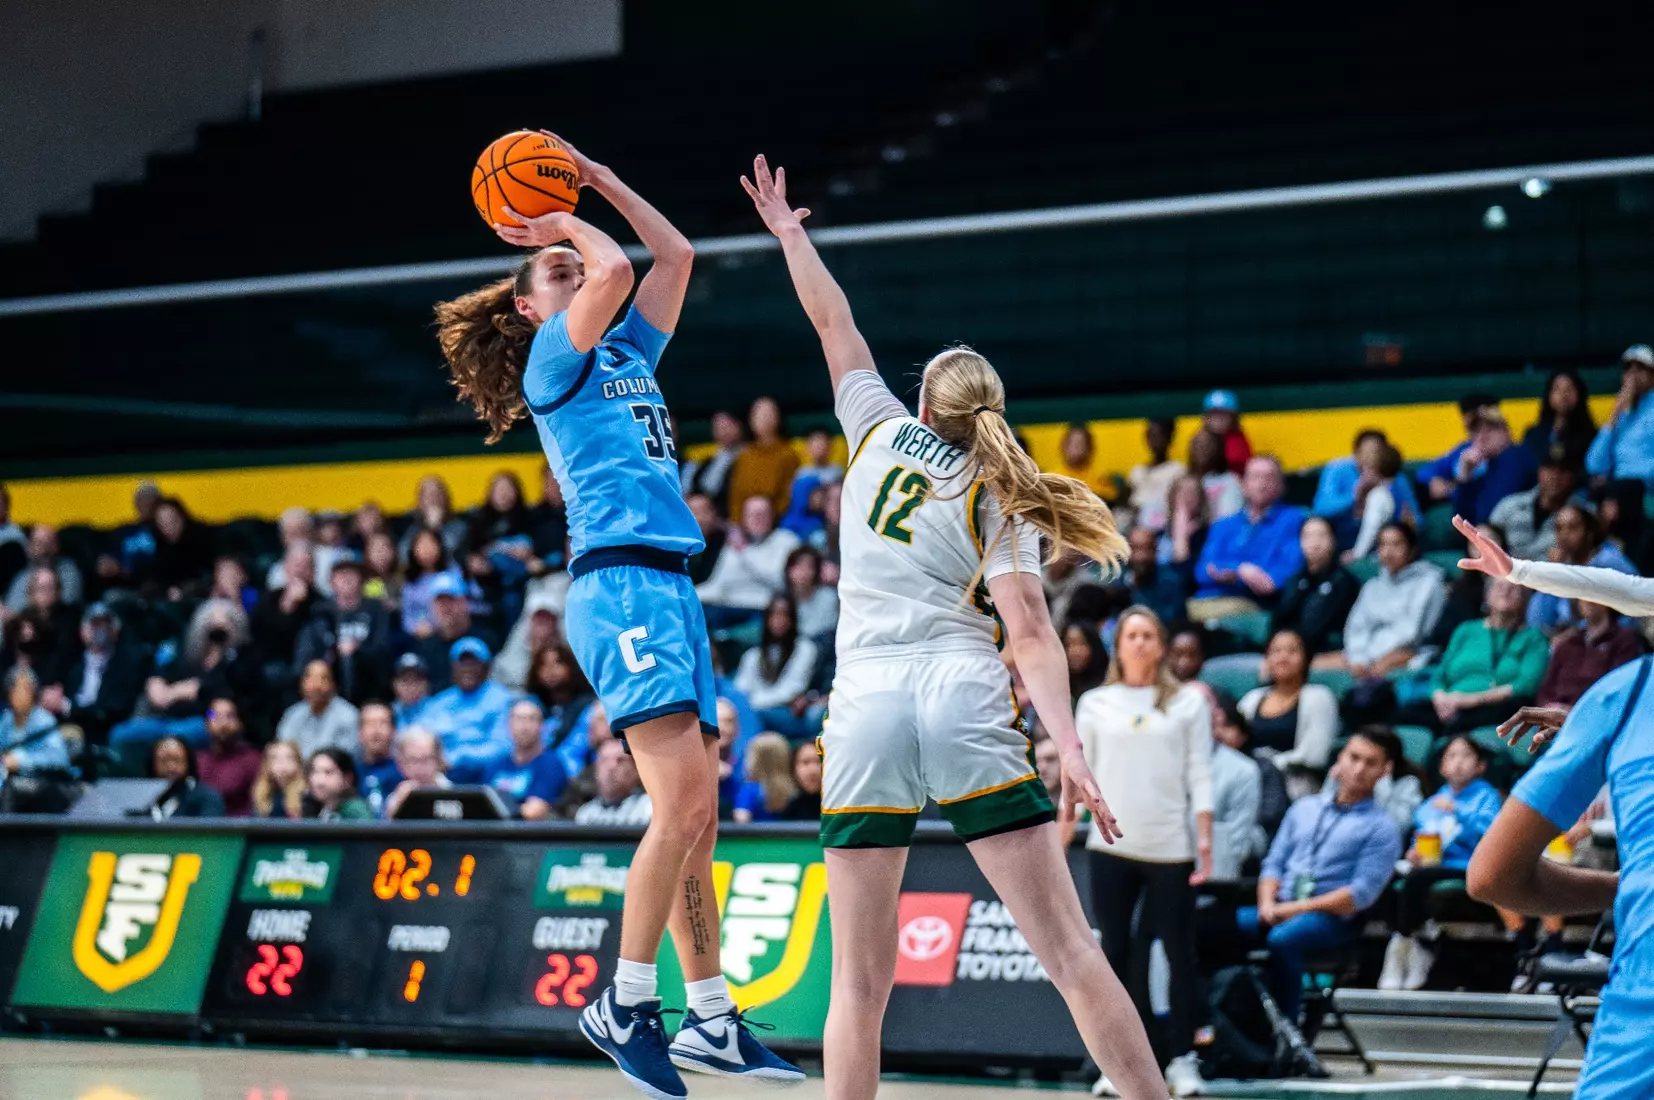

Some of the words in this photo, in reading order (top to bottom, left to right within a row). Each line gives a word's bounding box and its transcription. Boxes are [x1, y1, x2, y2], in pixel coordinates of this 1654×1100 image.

[536, 163, 580, 194] ilson
[628, 402, 678, 465] 35
[891, 421, 966, 472] WERTH
[867, 464, 932, 546] 12
[617, 625, 658, 675] C
[247, 908, 312, 942] HOME
[388, 925, 451, 952] PERIOD
[532, 916, 610, 950] GUEST
[246, 944, 304, 997] 22
[404, 960, 427, 1003] 1
[534, 953, 599, 1008] 22
